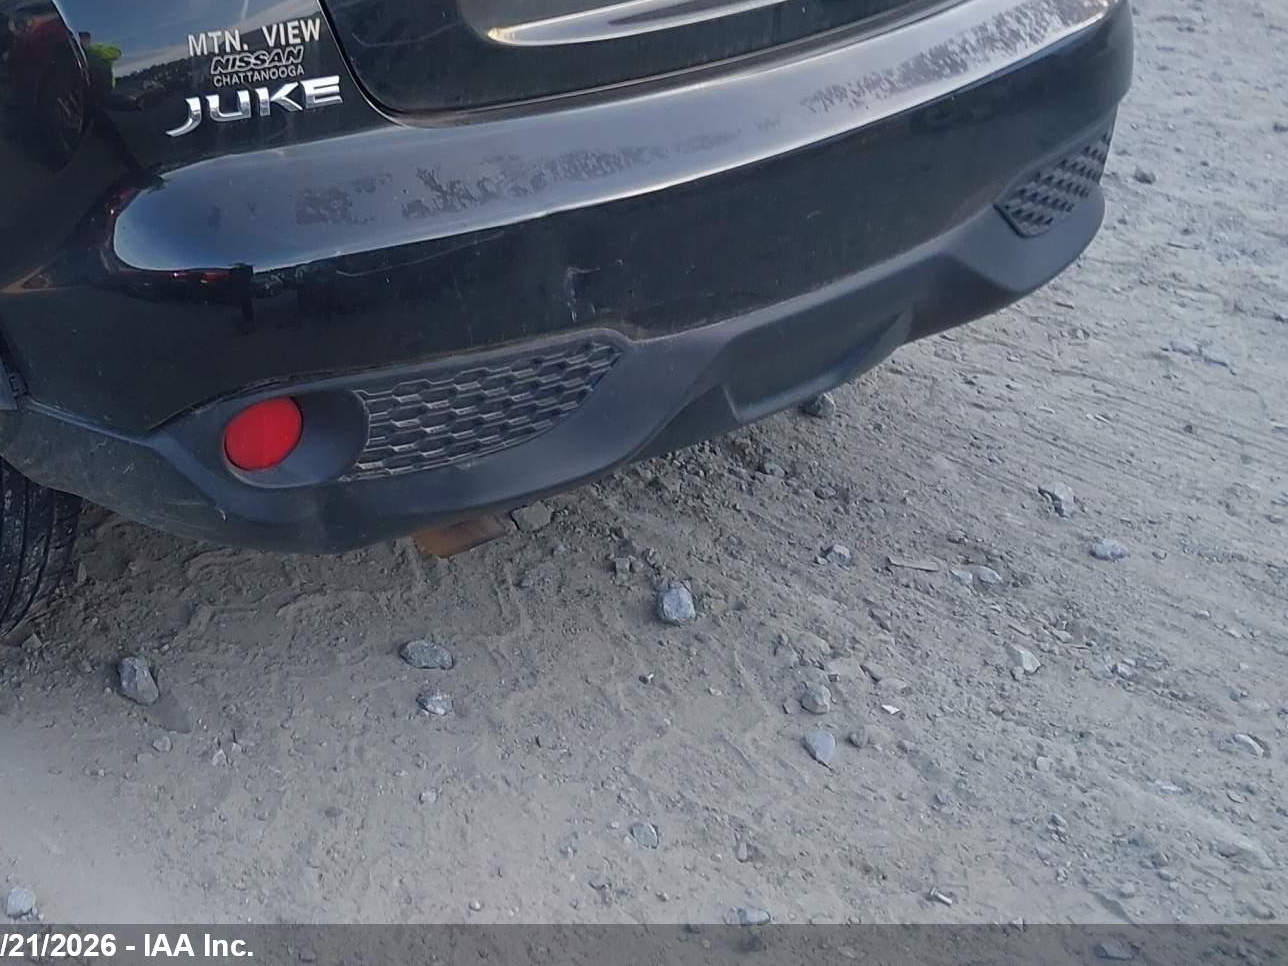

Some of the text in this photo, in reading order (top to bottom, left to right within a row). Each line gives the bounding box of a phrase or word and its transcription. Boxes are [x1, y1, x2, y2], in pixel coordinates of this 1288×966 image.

[187, 18, 321, 57] MTN. VIEW
[211, 45, 304, 74] NISSAN
[213, 64, 305, 88] CHATTANOOGA
[165, 75, 343, 137] JUKE
